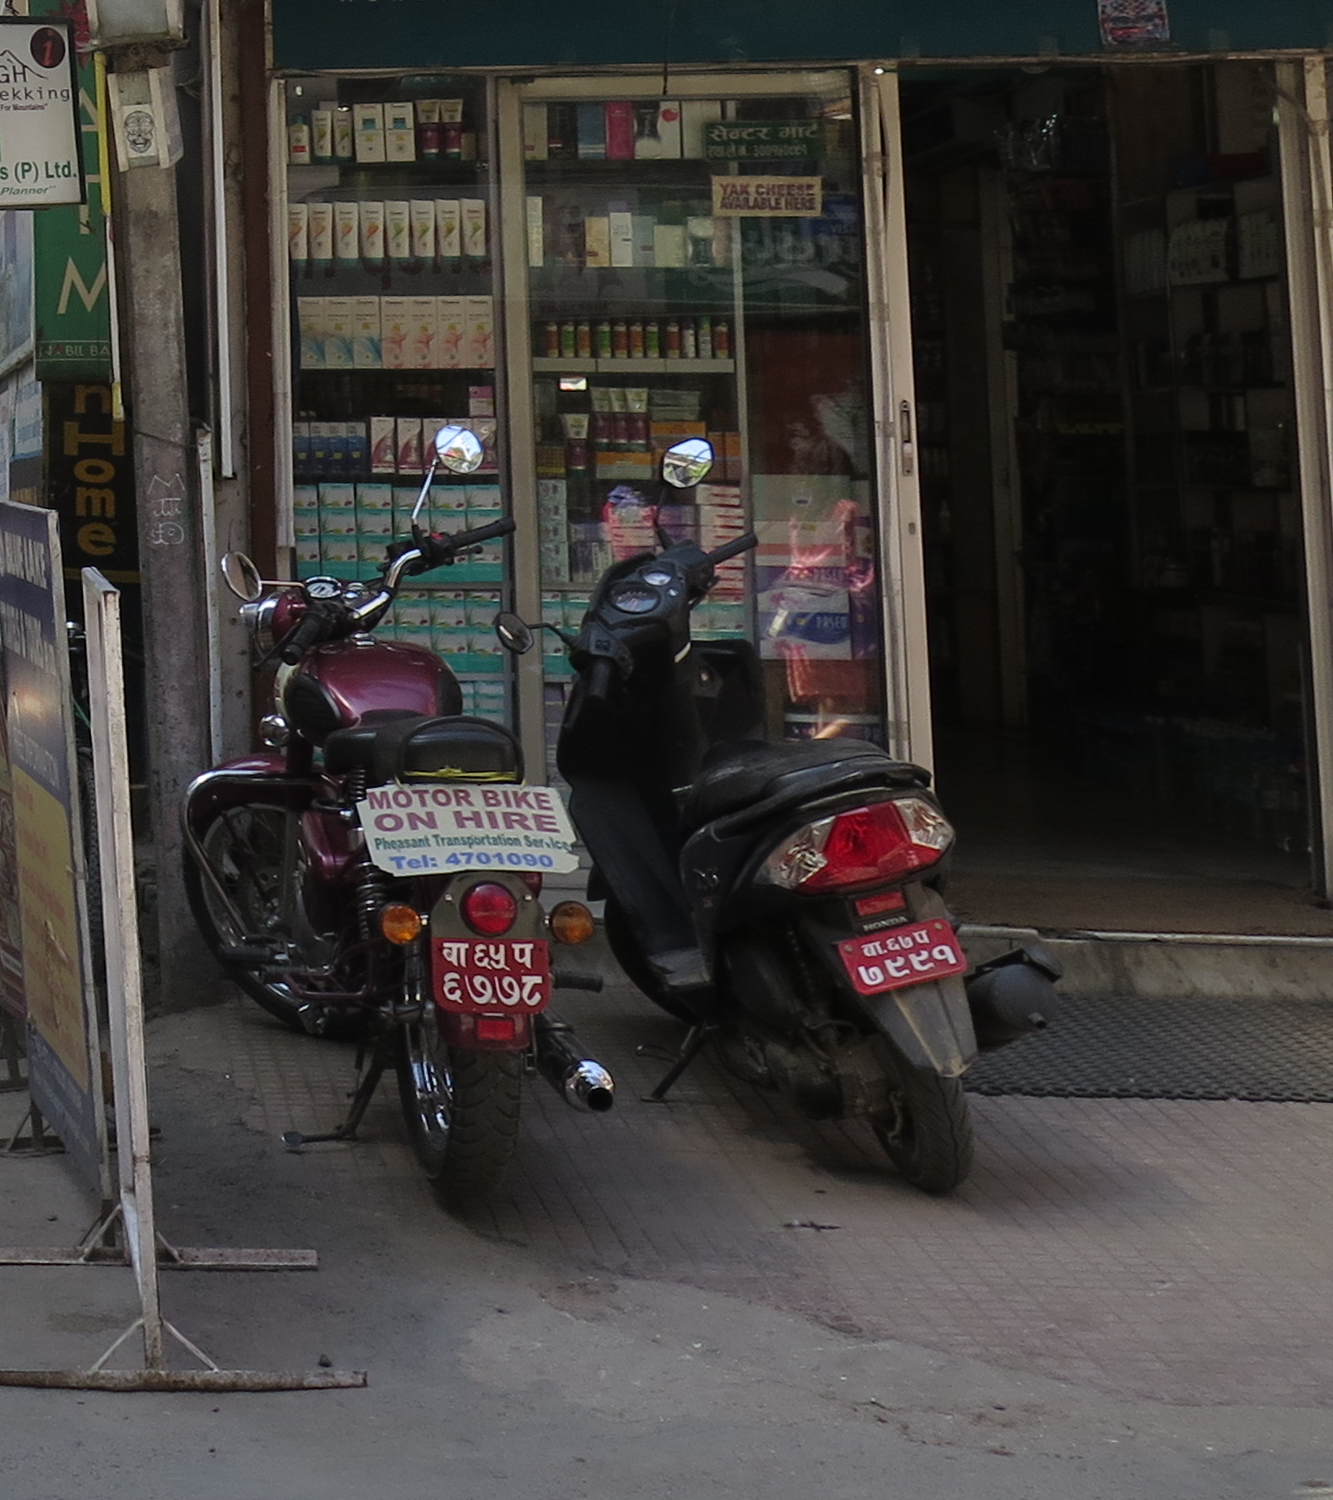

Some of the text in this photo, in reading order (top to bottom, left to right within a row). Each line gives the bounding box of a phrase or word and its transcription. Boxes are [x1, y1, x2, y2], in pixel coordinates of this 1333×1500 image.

[13, 163, 40, 185] (P)
[44, 160, 79, 180] Ltd.
[719, 183, 816, 197] YAK CHEESE
[366, 788, 555, 813] MOTOR BIKE
[373, 809, 562, 835] ON HIRE
[374, 835, 432, 853] Pheasant
[432, 833, 523, 850] Transportation
[389, 851, 554, 871] Tel: 4701090
[863, 914, 910, 933] HONDA
[442, 941, 469, 969] बा
